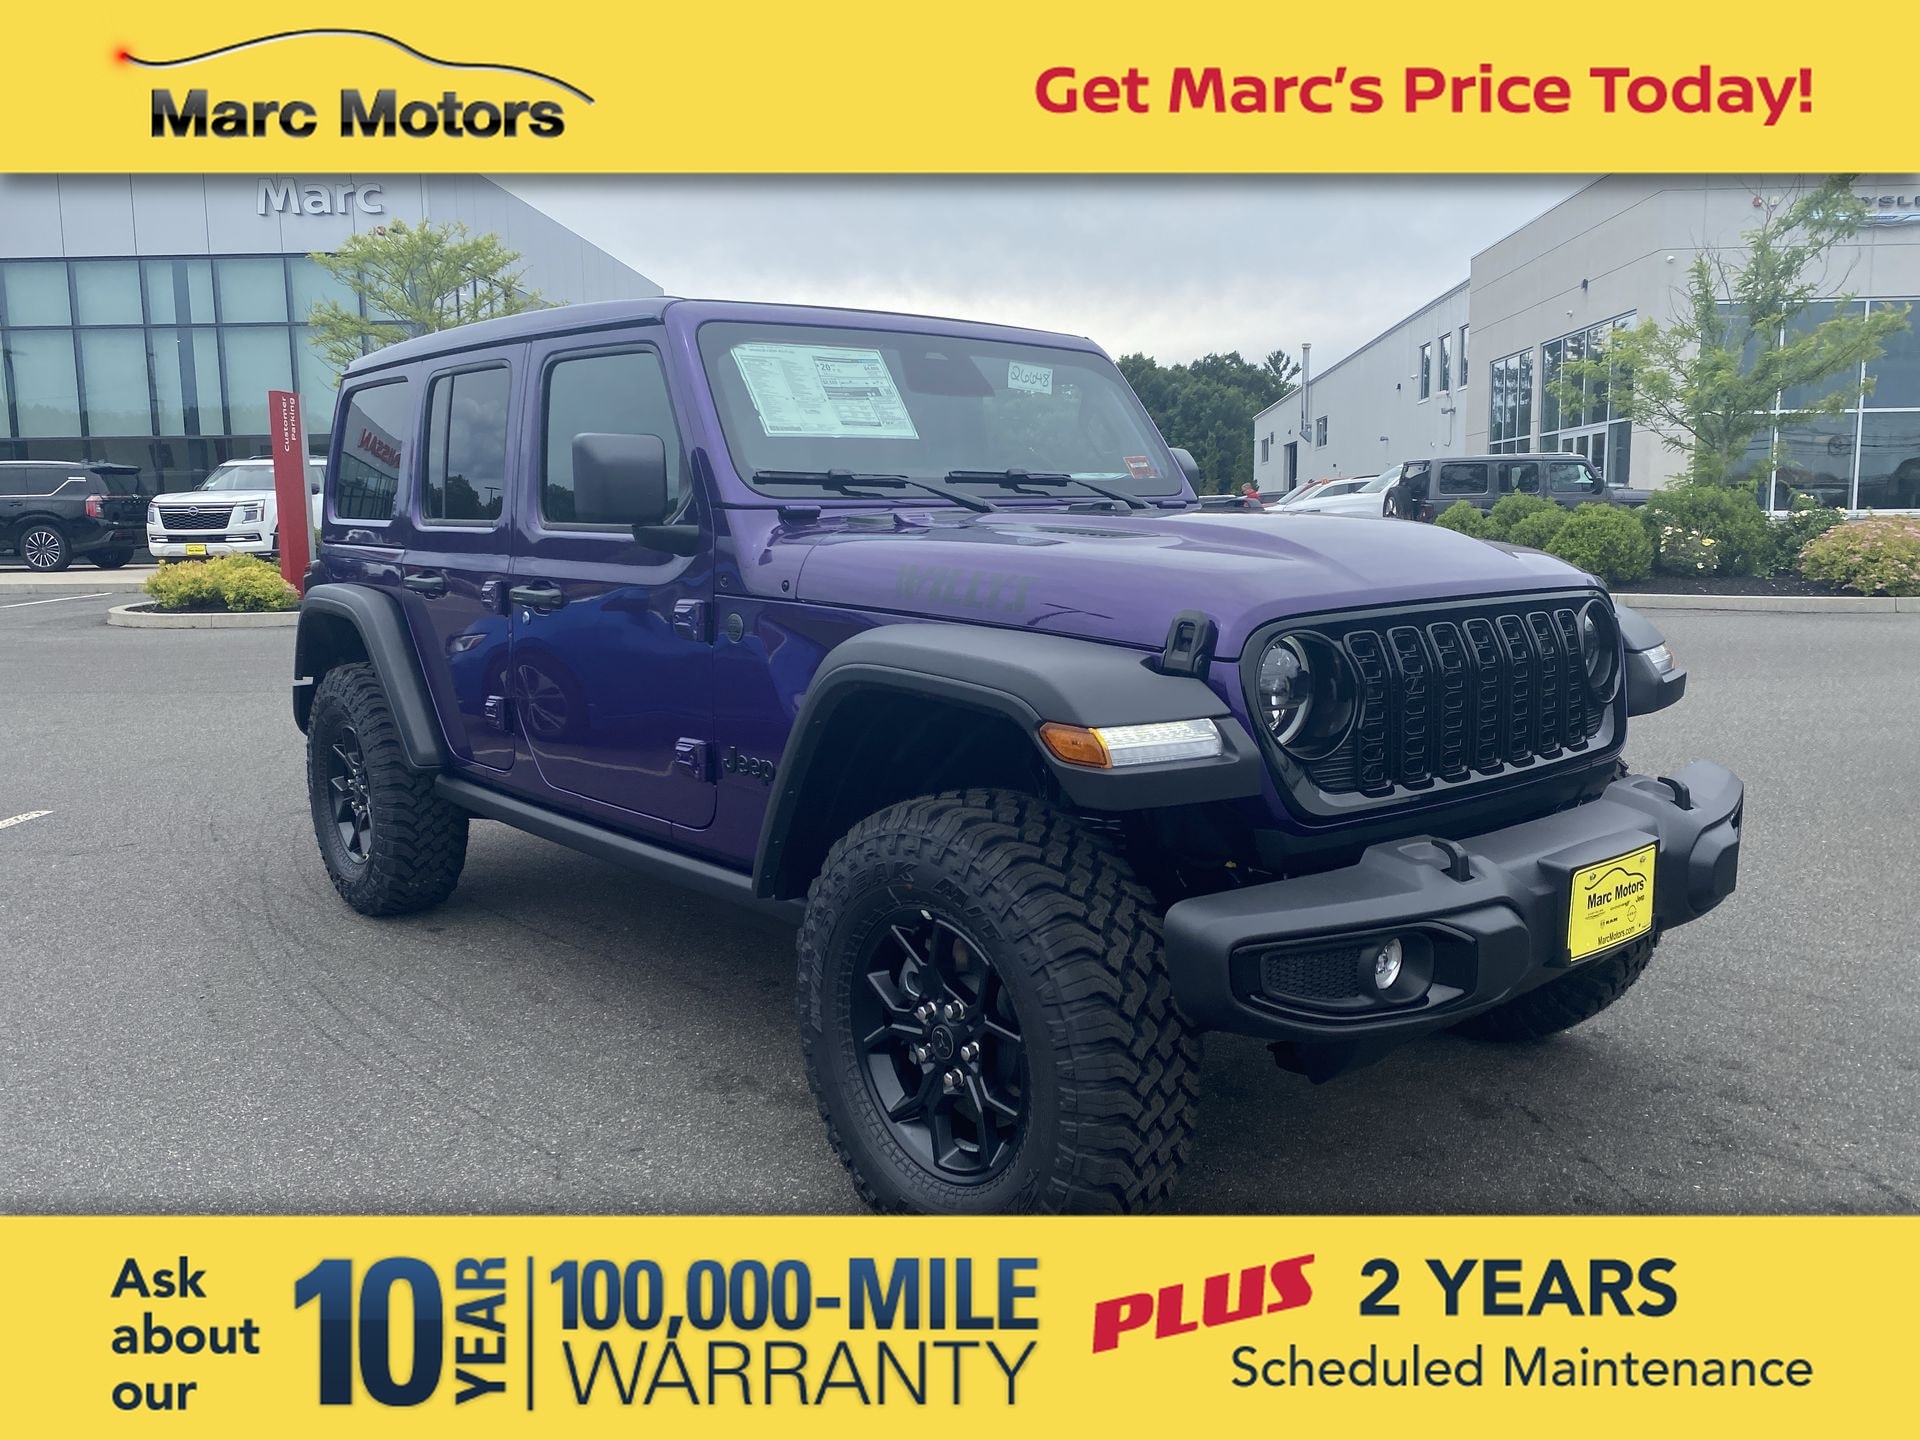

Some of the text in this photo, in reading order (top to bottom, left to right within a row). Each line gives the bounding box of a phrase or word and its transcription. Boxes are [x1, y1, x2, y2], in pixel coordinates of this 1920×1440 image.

[257, 177, 384, 216] Marc
[281, 396, 290, 452] Customer
[289, 397, 297, 441] Parking
[722, 745, 776, 786] Jeep
[1587, 892, 1612, 910] Marc
[1615, 879, 1645, 901] Motors
[1597, 926, 1636, 946] MarcMotors.com
